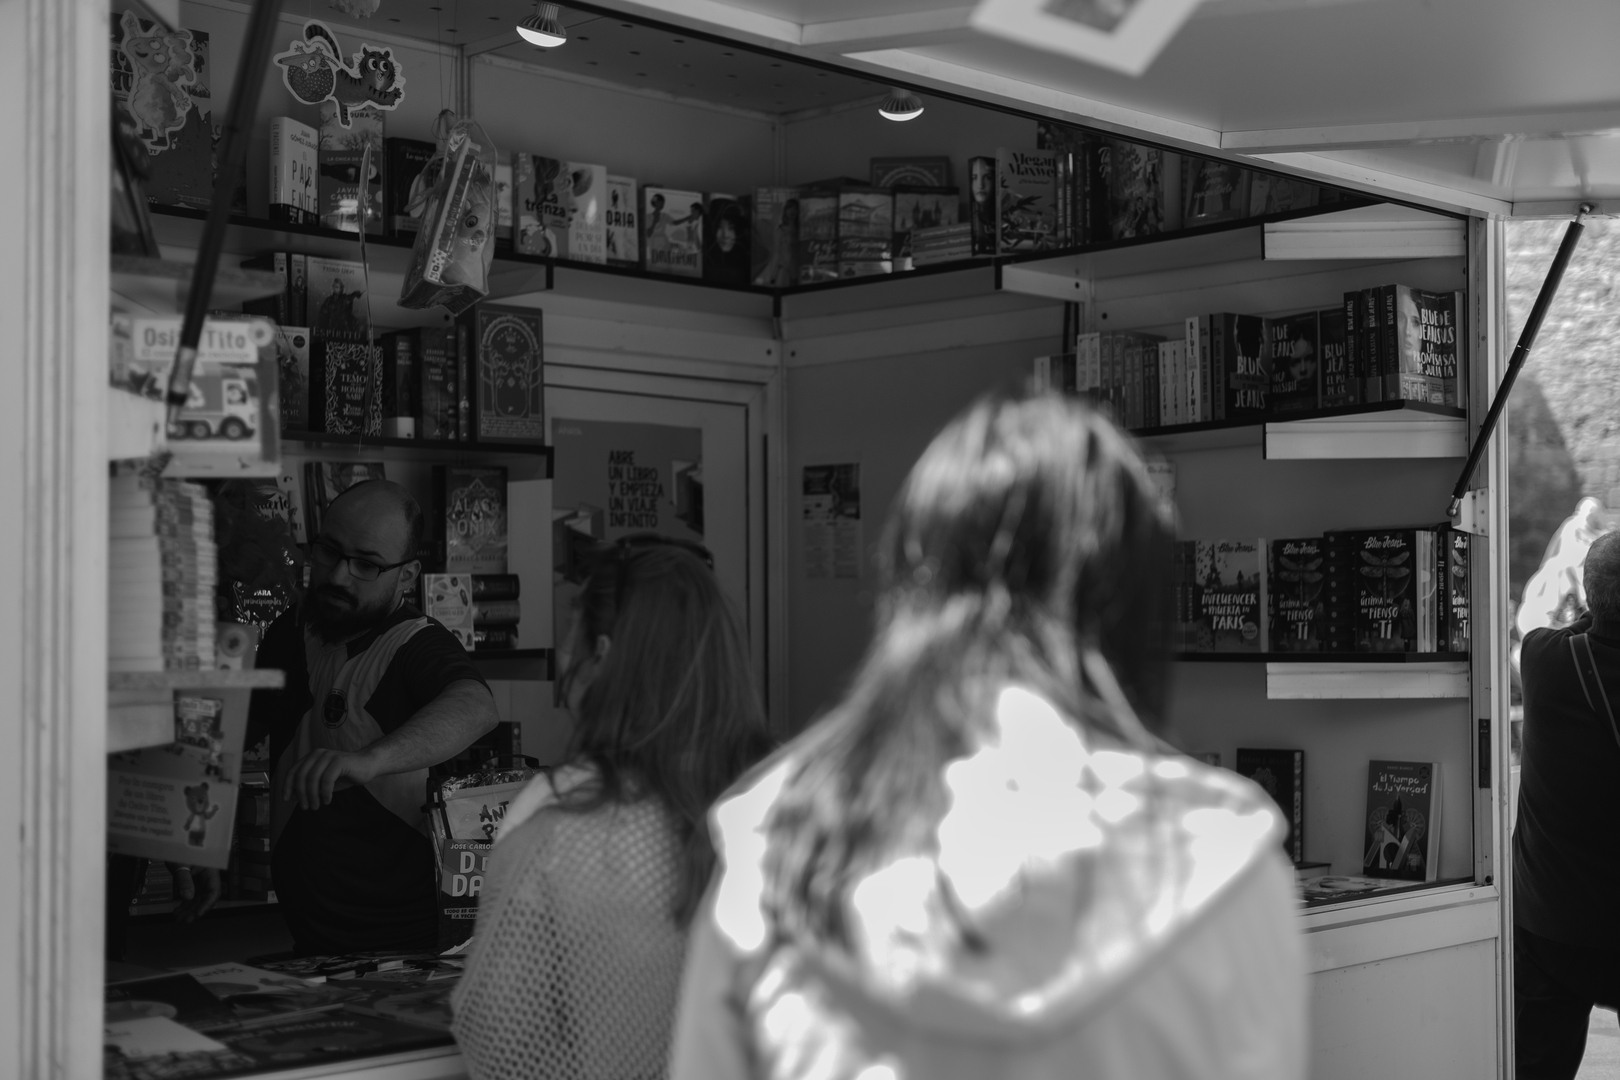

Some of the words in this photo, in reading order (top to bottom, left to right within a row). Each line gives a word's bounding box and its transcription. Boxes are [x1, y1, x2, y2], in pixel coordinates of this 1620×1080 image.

[1012, 152, 1056, 168] Megan
[1008, 163, 1057, 178] Maxwel
[544, 186, 558, 204] La
[525, 198, 566, 217] trenza
[606, 210, 635, 228] ORIA
[1420, 308, 1439, 326] BLUE
[206, 330, 246, 349] Tito
[313, 326, 361, 341] ESPÍRITU
[1272, 324, 1288, 341] LUE
[1272, 339, 1296, 358] EANS
[1237, 355, 1261, 376] BLUE
[340, 373, 368, 383] TEMO
[1327, 375, 1334, 385] EL
[1327, 386, 1335, 396] DE
[1235, 390, 1266, 409] JEANS
[608, 450, 635, 466] ABRE
[608, 466, 624, 481] UN
[627, 466, 658, 482] LIBRO
[608, 482, 617, 496] Y
[620, 482, 664, 497] EMPIEZA
[609, 497, 625, 512] UN
[628, 497, 658, 513] VIAJE
[609, 512, 658, 528] INFINITO
[1217, 543, 1233, 553] Blue
[1235, 542, 1256, 553] Jeans
[1282, 542, 1299, 555] Blue
[1300, 541, 1320, 555] Jeans
[1364, 536, 1382, 549] Blue
[1383, 535, 1407, 549] Jeans
[243, 597, 283, 607] principiantes
[1201, 593, 1257, 606] INFLUENCER
[1287, 609, 1313, 622] PIENSO
[1369, 606, 1398, 620] PIENSO
[119, 775, 132, 785] Por
[141, 781, 174, 792] compra
[1379, 772, 1388, 783] El
[1389, 774, 1419, 786] Tiempo
[145, 791, 165, 802] libro
[1372, 782, 1383, 792] de
[1394, 783, 1428, 797] Verdad
[128, 800, 148, 811] Osito
[479, 801, 509, 822] ANT
[147, 816, 172, 825] parche
